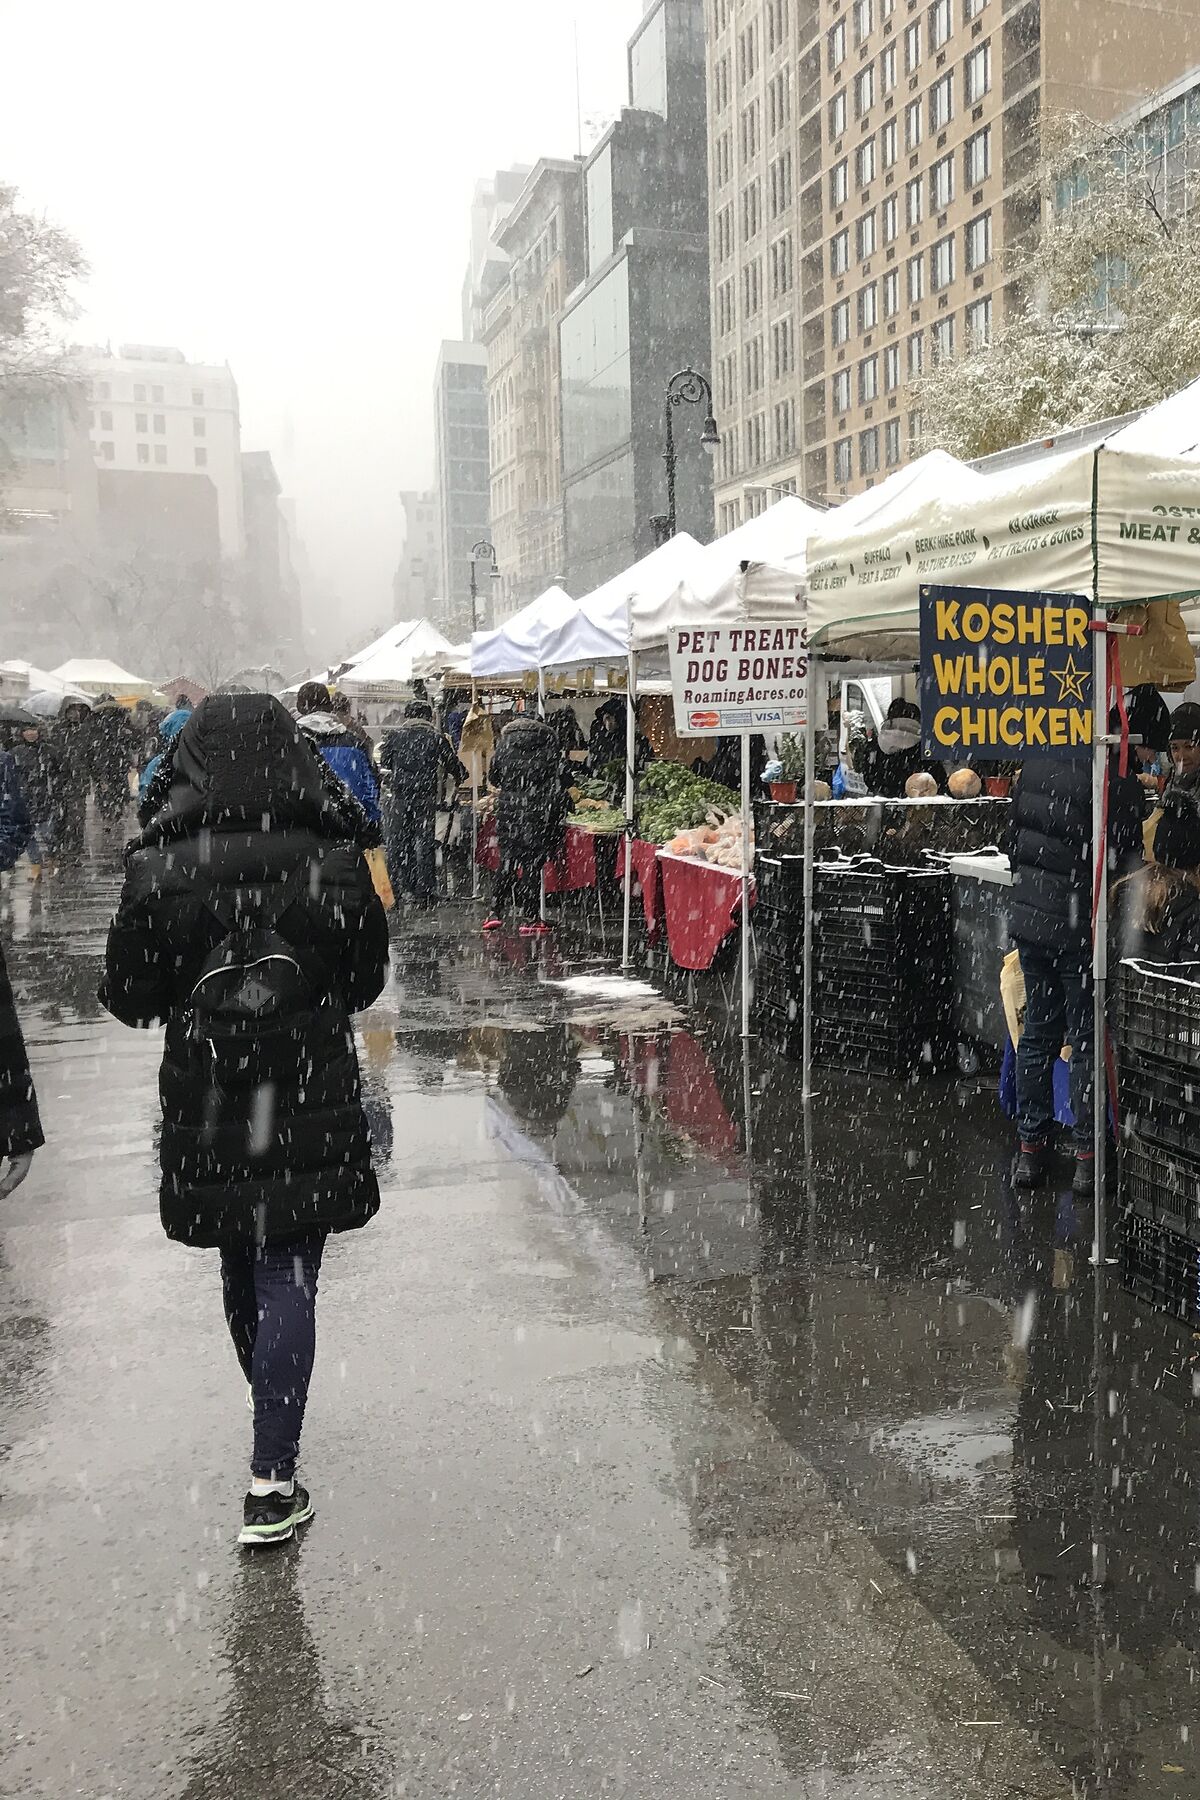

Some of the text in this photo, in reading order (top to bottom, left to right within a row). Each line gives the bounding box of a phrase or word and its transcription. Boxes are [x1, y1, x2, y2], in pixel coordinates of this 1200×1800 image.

[955, 528, 978, 548] PORK
[1049, 523, 1085, 546] BONES
[1119, 522, 1180, 543] MEAT
[935, 600, 1088, 649] KOSHER
[677, 627, 807, 654] PET TREATS
[686, 656, 808, 683] DOG BONES
[932, 653, 1046, 696] WHOLE
[755, 712, 781, 721] VISA
[933, 706, 1094, 746] CHICKEN
